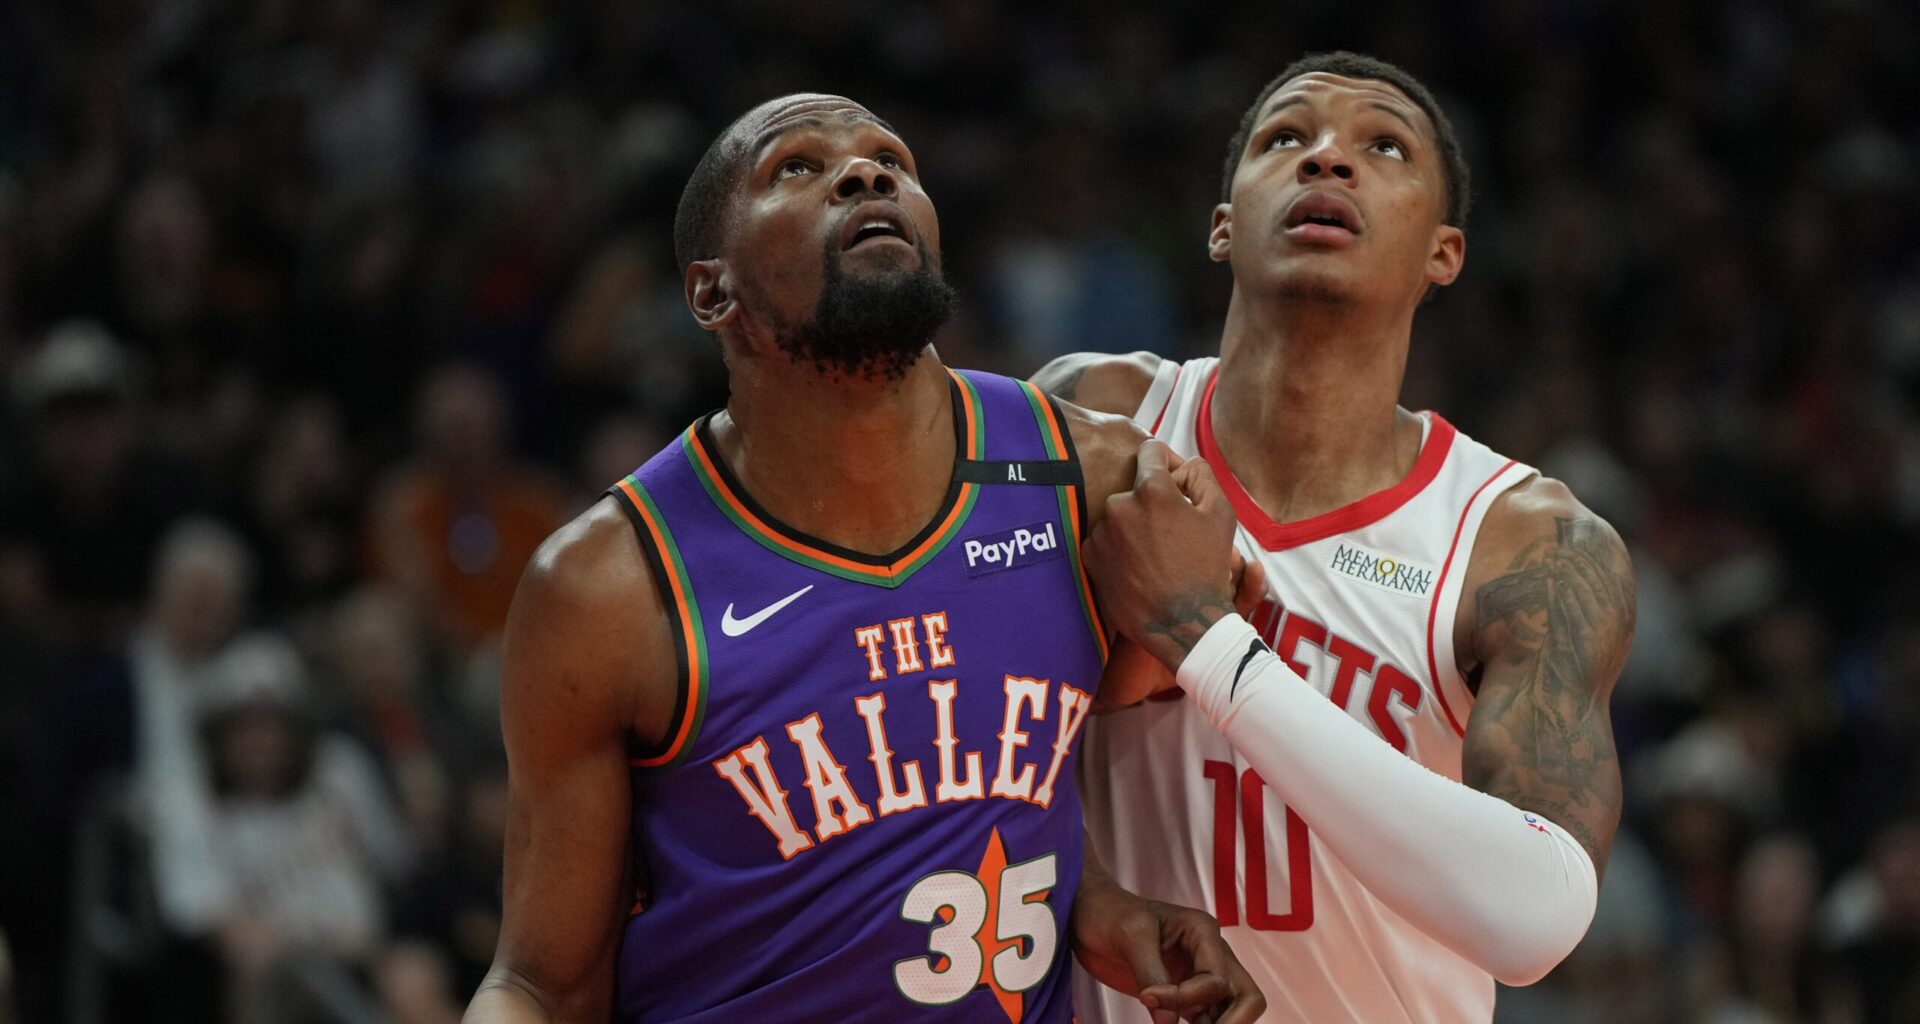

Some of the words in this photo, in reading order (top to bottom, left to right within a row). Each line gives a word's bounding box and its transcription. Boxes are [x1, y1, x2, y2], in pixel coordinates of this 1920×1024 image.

[1007, 463, 1027, 482] AL
[964, 522, 1057, 568] PayPal
[1333, 543, 1433, 585] MEMORIAL
[1330, 556, 1431, 595] HERMANN
[854, 610, 956, 682] THE
[712, 673, 1093, 862] VALLEY
[1203, 759, 1315, 932] 10
[892, 851, 1058, 1007] 35
